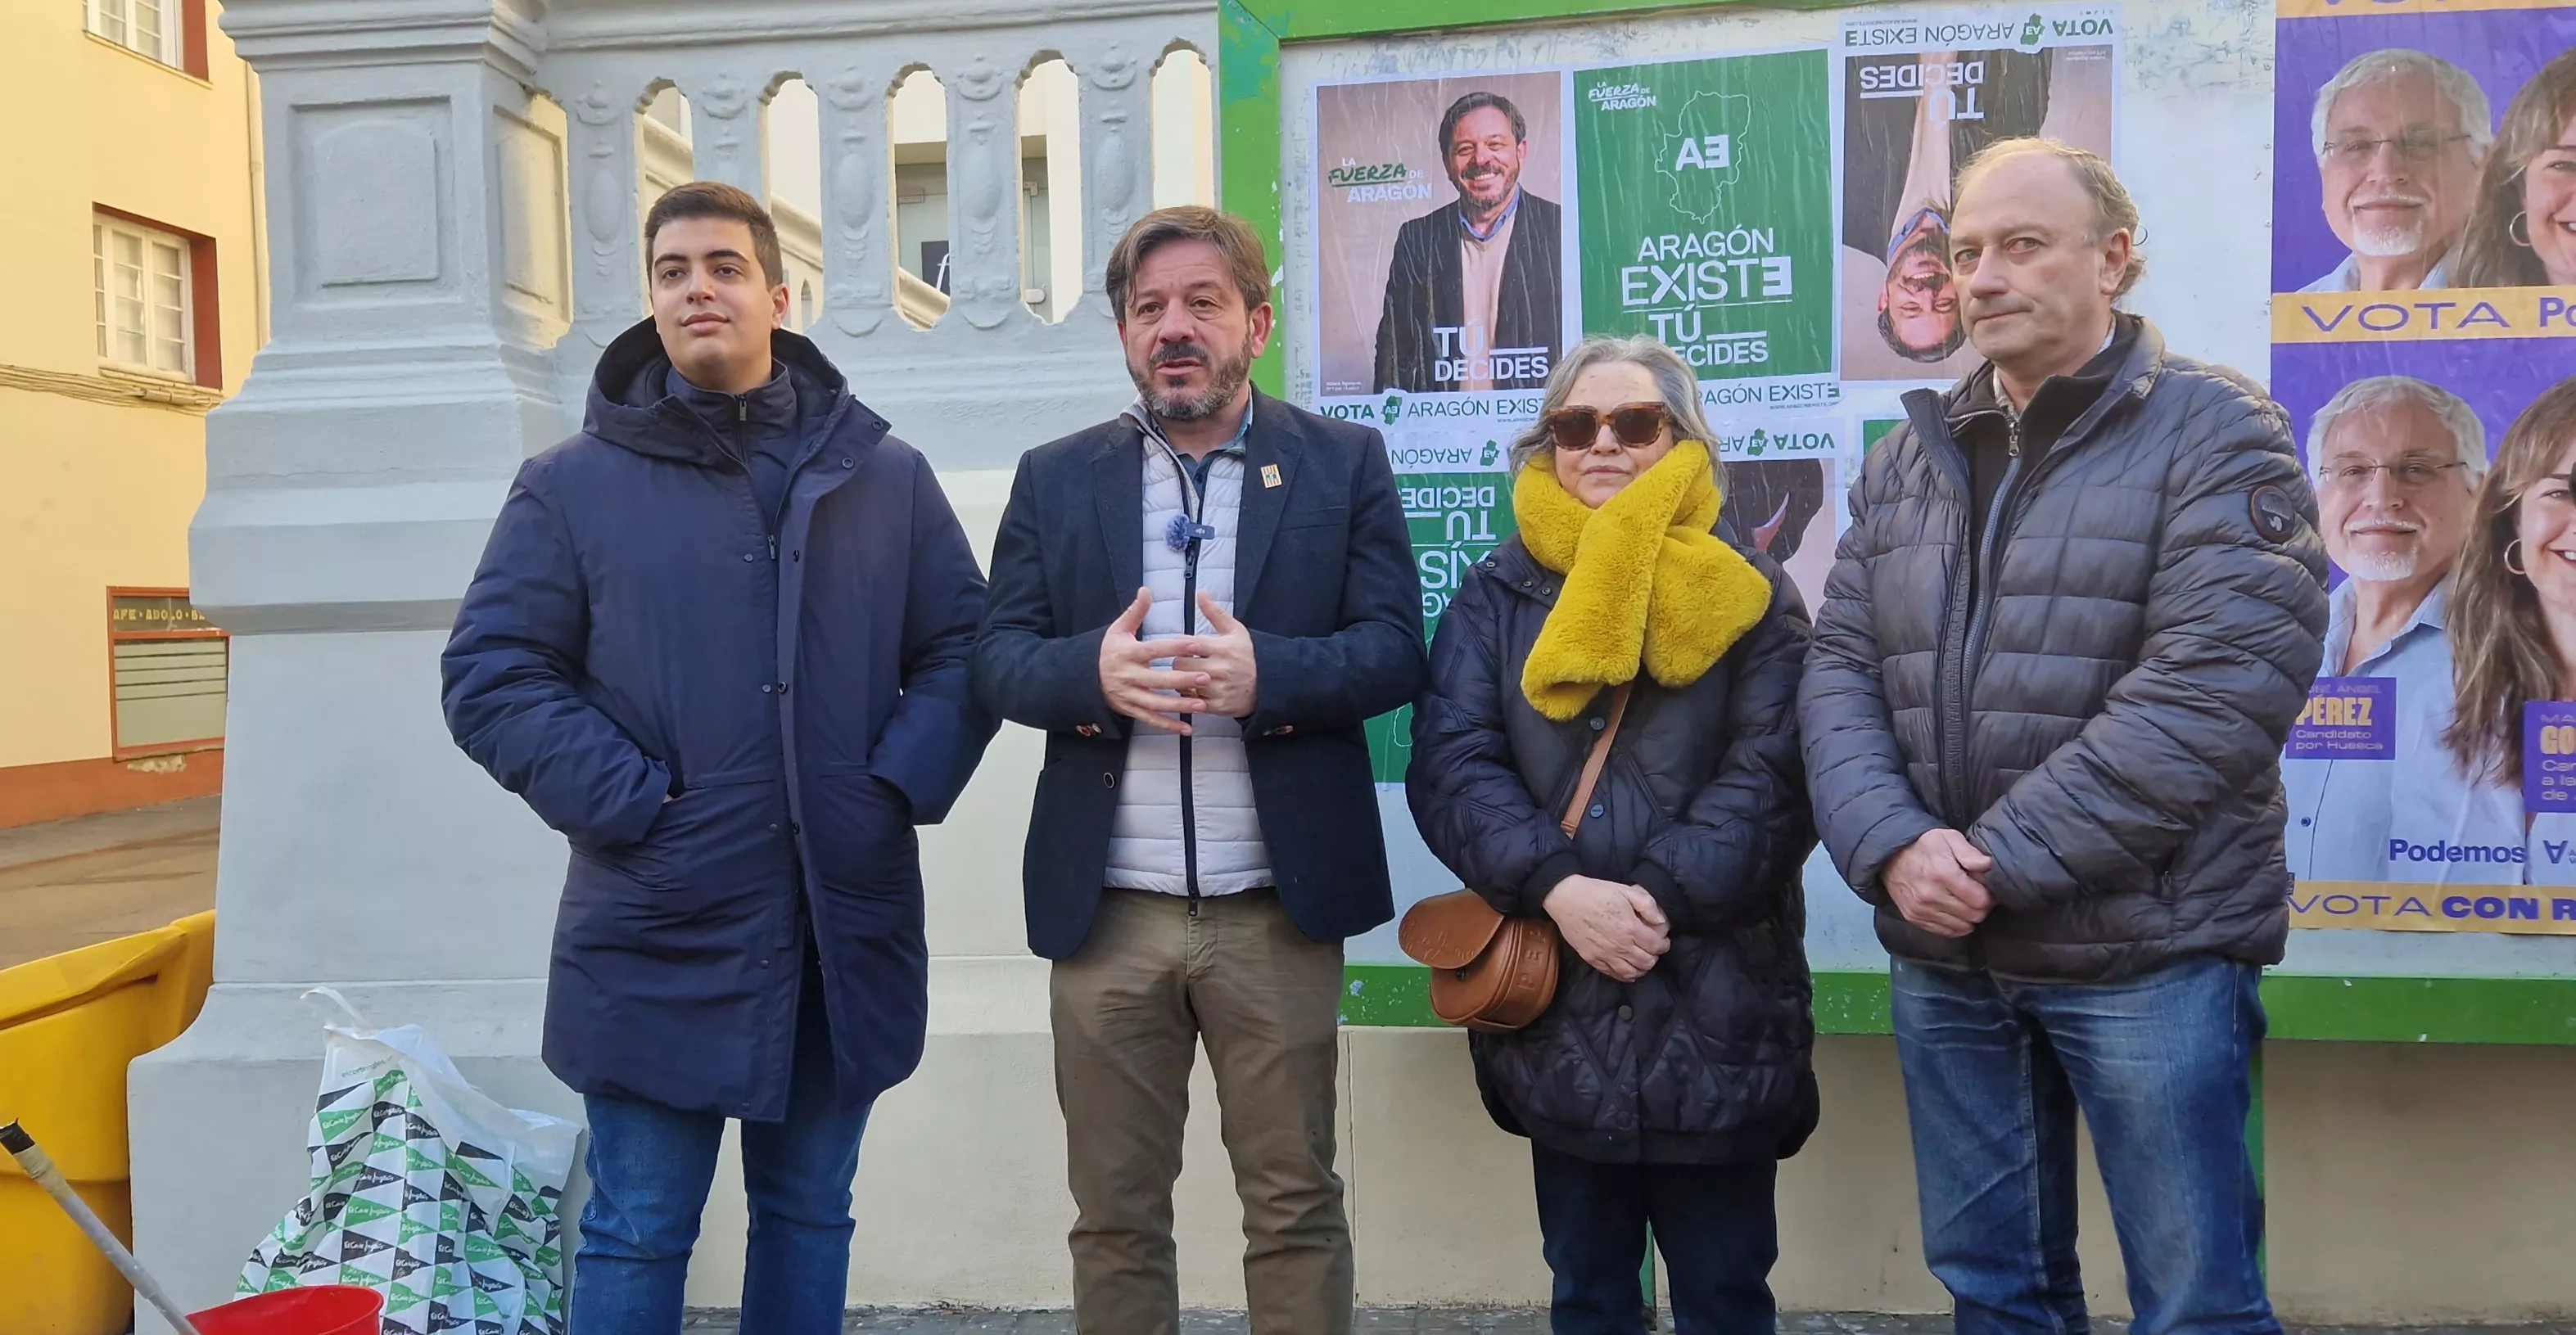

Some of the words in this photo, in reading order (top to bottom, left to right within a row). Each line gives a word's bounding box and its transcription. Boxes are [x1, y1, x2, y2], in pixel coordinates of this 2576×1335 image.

[1845, 27, 1917, 47] EXISTE
[1925, 22, 2014, 47] ARAGÓN
[2052, 19, 2113, 37] VOTA
[1860, 61, 1984, 89] DECIDES
[1588, 83, 1639, 100] FUERZA
[1601, 95, 1656, 111] ARAGÓN
[1328, 163, 1407, 184] FUERZA
[1409, 169, 1424, 178] DE
[1342, 157, 1356, 167] LA
[1347, 180, 1432, 203] ARAGÓN
[1638, 223, 1774, 262] ARAGÓN
[1621, 256, 1792, 306] EXISTE
[1648, 304, 1702, 344] TÚ
[2302, 301, 2511, 332] VOTA
[1434, 317, 1484, 357] TÚ
[1671, 340, 1769, 366] ECIDES
[1435, 356, 1549, 382] DECIDES
[1320, 404, 1375, 420] VOTA
[1408, 397, 1489, 417] ARAGÓN
[1774, 433, 1835, 449] VOTA
[1391, 448, 1471, 468] ARAGÓN
[1398, 486, 1496, 508] DECIDE
[2296, 730, 2372, 739] Candidato
[2296, 742, 2322, 751] por
[2327, 741, 2384, 750] Huesca
[2542, 790, 2568, 801] de
[2389, 839, 2527, 864] Podemos
[2286, 894, 2433, 918] VOTA
[2442, 895, 2539, 920] CON
